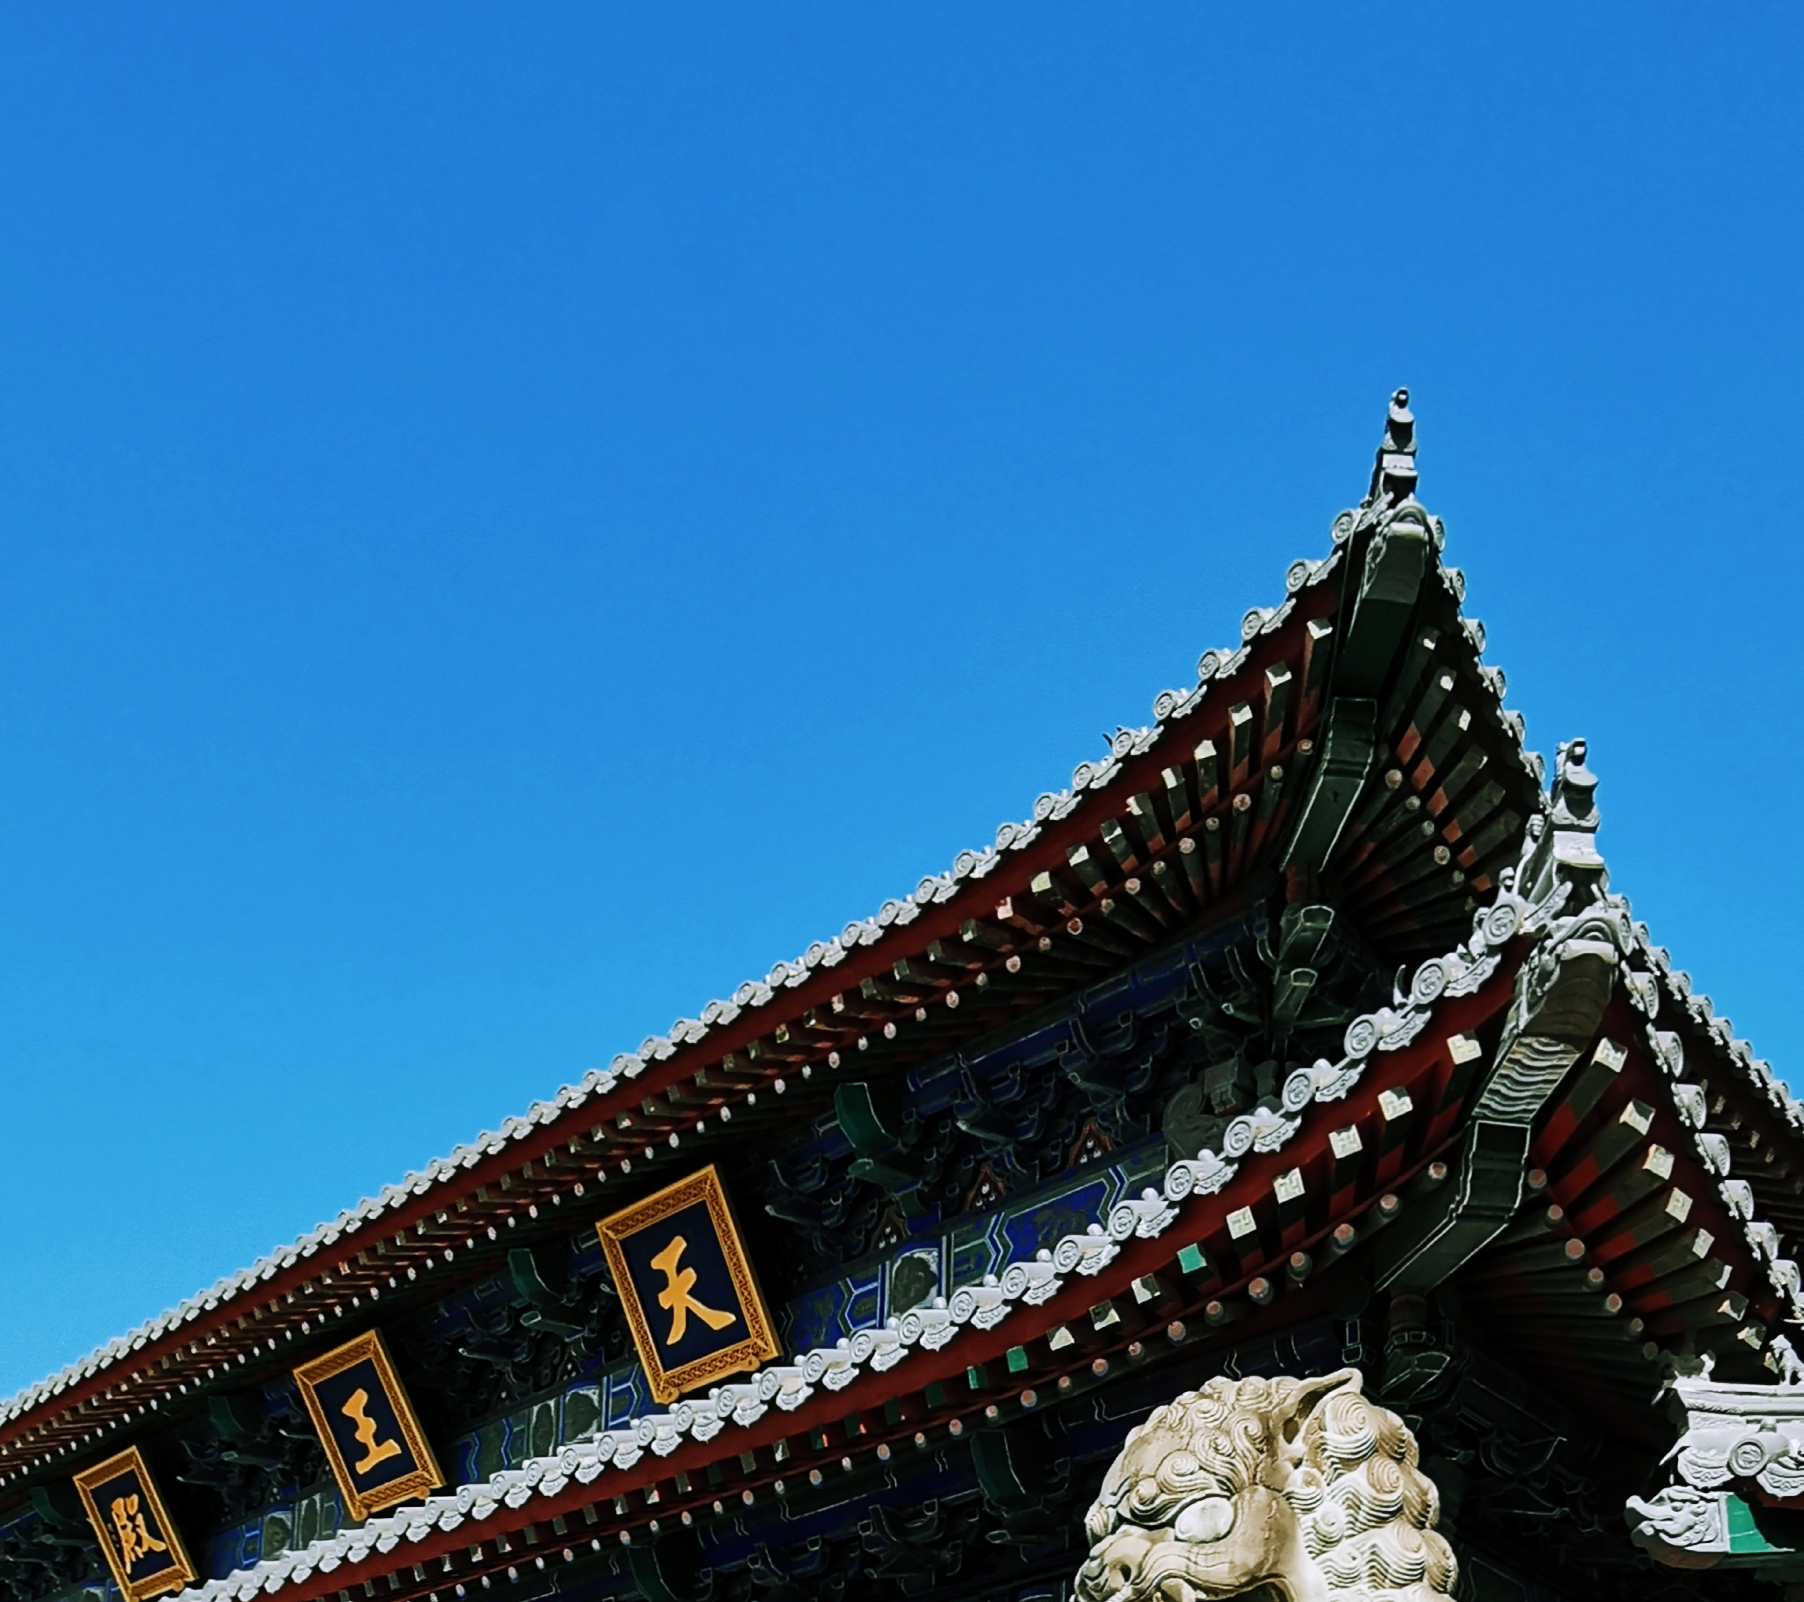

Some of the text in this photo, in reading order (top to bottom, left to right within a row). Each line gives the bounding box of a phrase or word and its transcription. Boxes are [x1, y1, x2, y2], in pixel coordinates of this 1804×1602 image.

[650, 1235, 737, 1345] 天
[341, 1387, 402, 1475] 王
[111, 1493, 167, 1575] 殿
